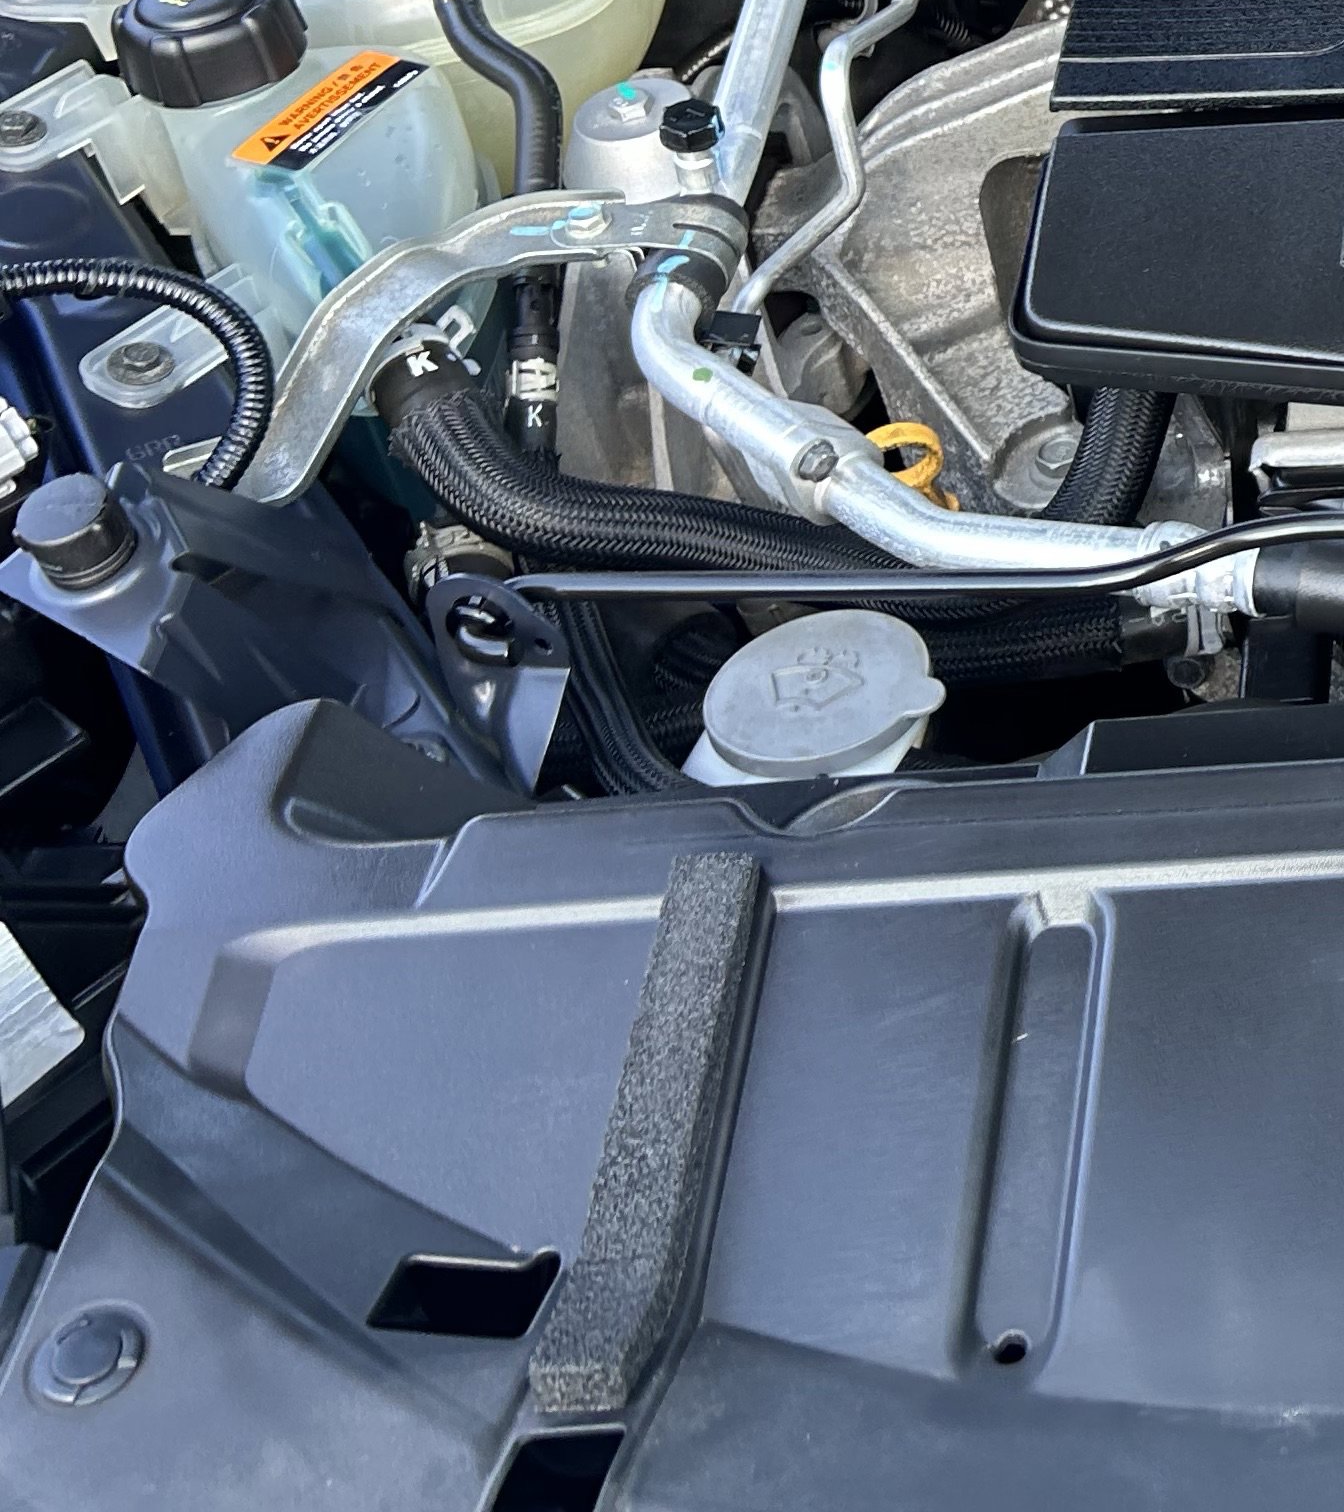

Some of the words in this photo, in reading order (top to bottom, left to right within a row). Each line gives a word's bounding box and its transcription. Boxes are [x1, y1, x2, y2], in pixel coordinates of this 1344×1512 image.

[278, 86, 334, 126] WARNING
[293, 62, 382, 131] AVERTISSEMENT
[406, 351, 439, 377] K
[526, 403, 543, 428] K
